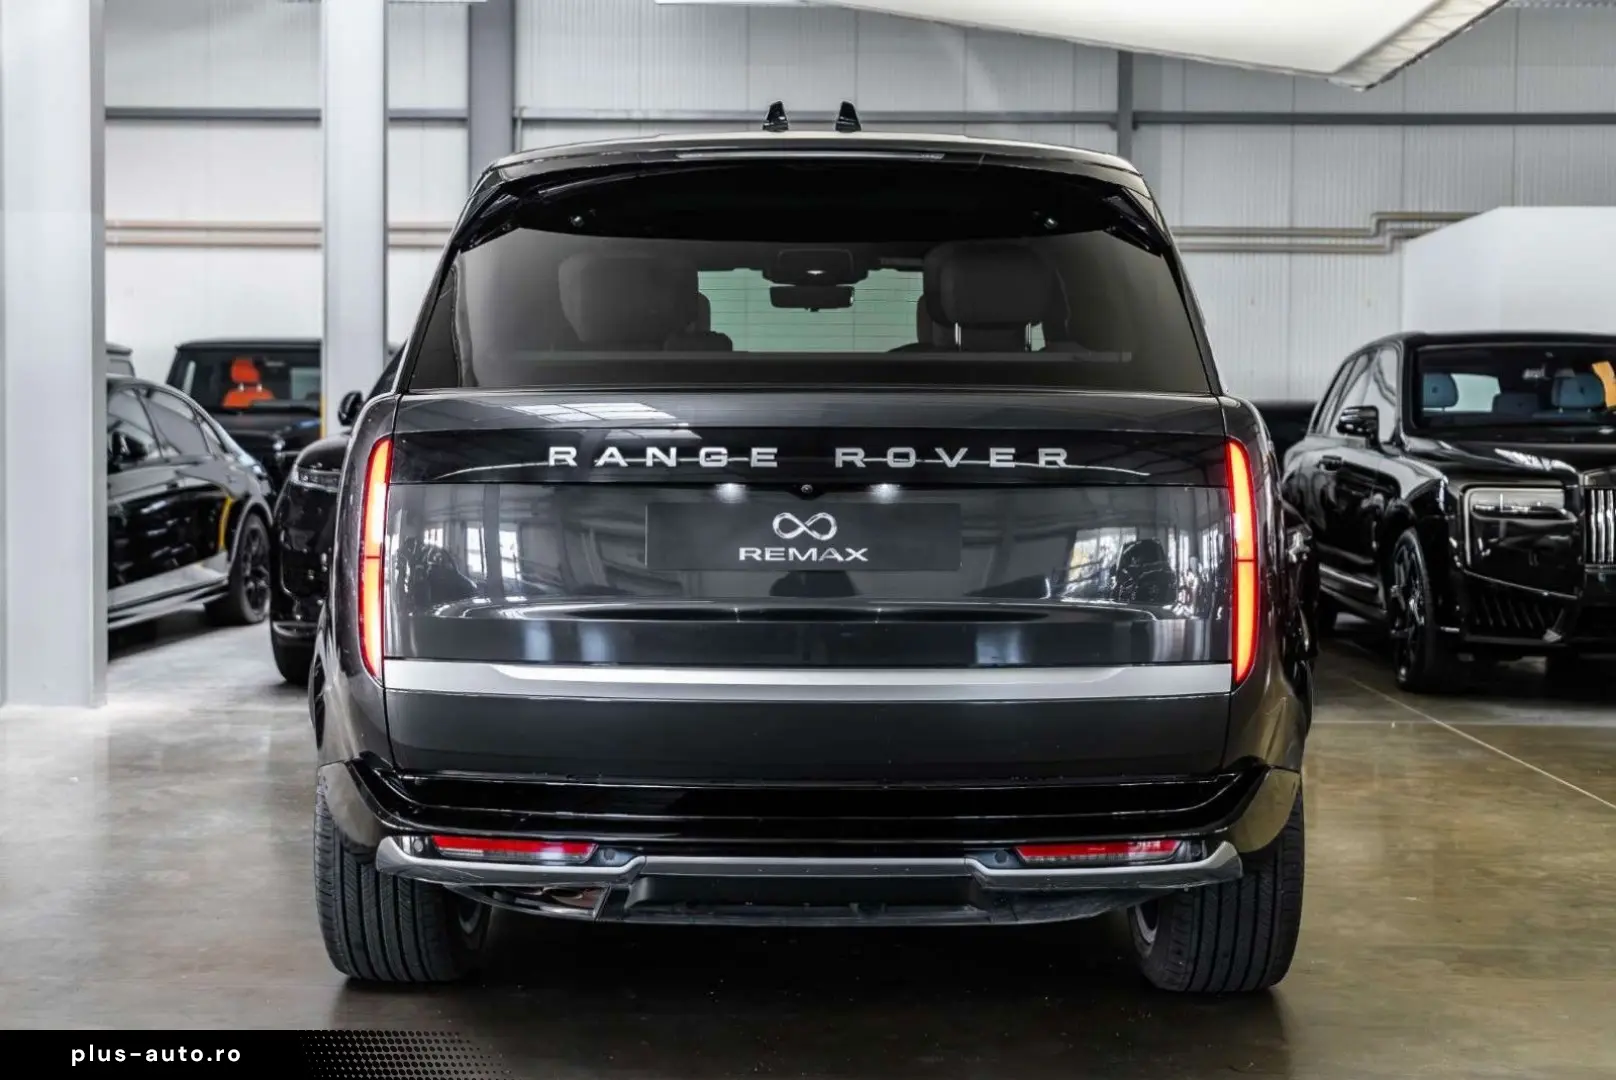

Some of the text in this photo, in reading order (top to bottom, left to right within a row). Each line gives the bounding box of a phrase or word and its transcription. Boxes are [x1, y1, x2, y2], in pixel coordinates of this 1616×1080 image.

[548, 446, 1069, 468] RANGE ROVER
[739, 547, 869, 562] REMAX
